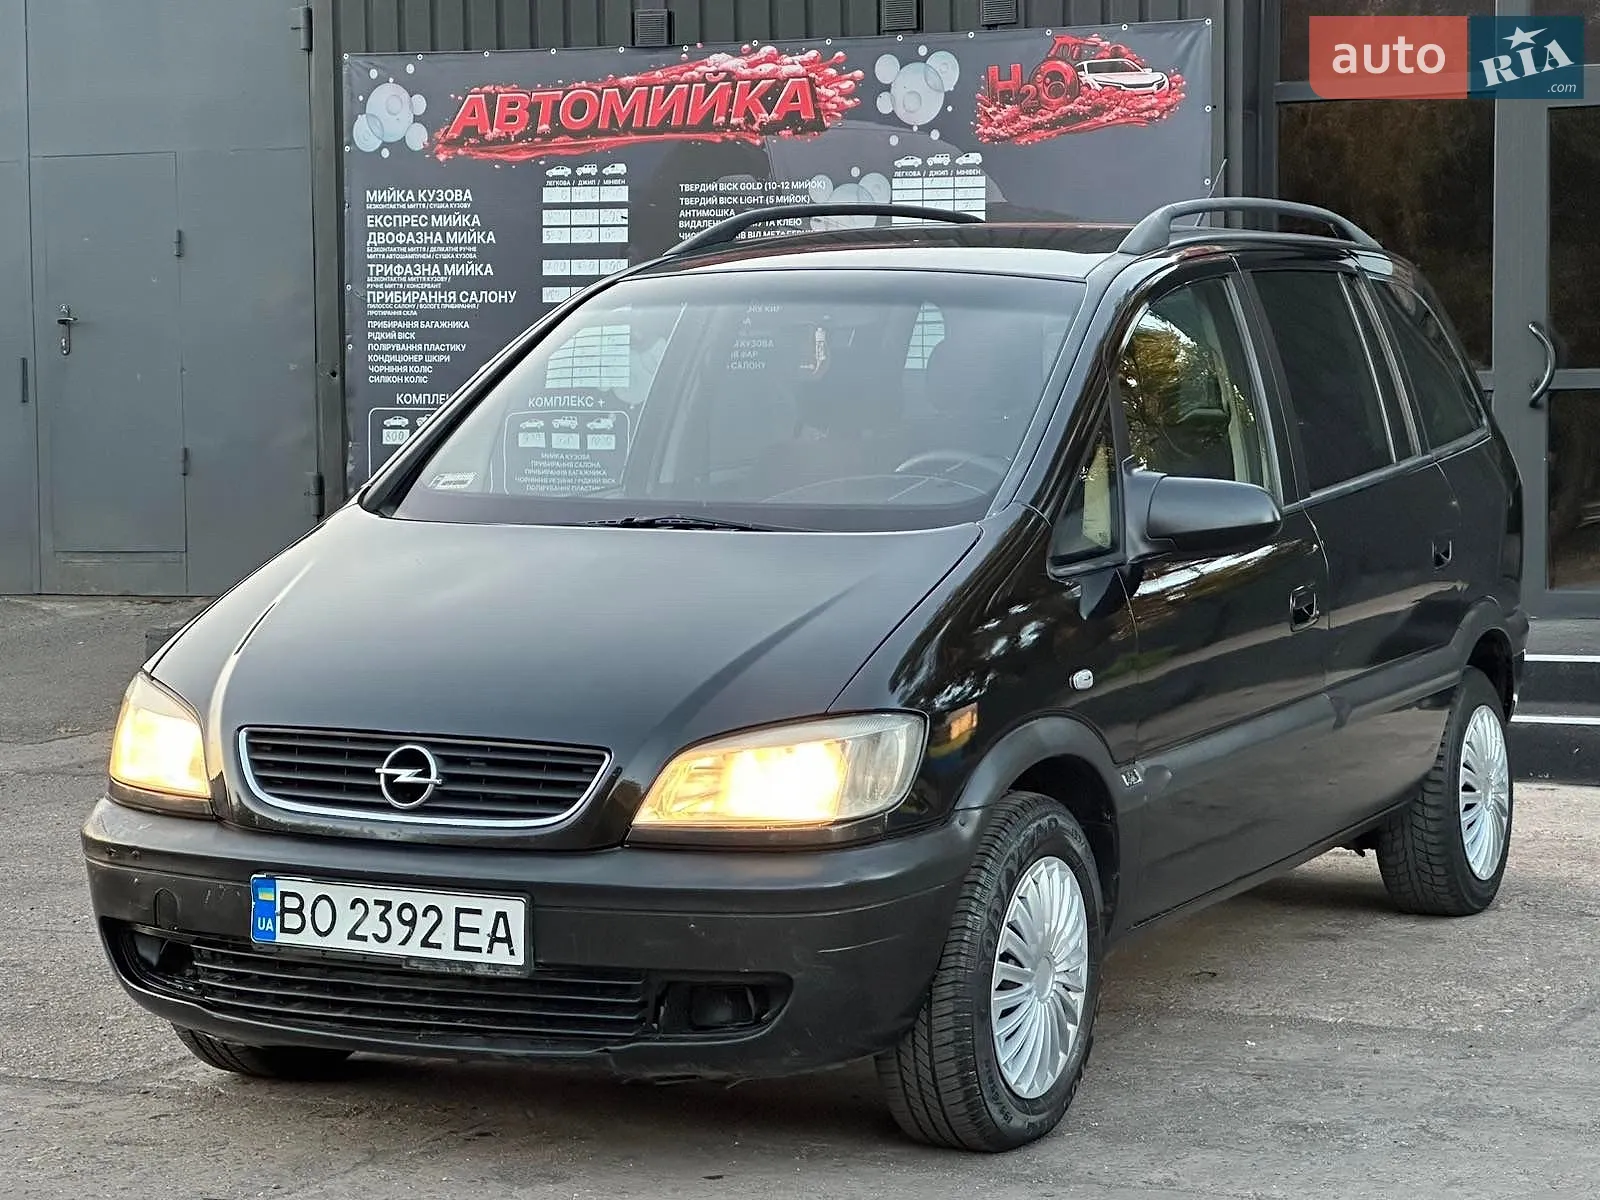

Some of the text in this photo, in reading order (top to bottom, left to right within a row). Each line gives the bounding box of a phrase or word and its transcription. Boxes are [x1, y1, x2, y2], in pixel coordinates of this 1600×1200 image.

[448, 71, 816, 138] АВТОМИЙКА
[679, 181, 718, 193] ТВЕРДИЙ
[739, 182, 763, 191] GOLD
[764, 181, 790, 192] (10-12
[791, 180, 826, 190] МИЙОК)
[366, 187, 473, 202] МИЙКА КУЗОВА
[679, 196, 718, 206] ТВЕРДИЙ
[739, 195, 764, 204] LIGHT
[765, 195, 775, 205] (5
[775, 194, 811, 204] МИЙОК)
[366, 211, 481, 228] ЕКСПРЕС МИЙКА
[679, 209, 735, 218] АНТИМОШКА
[776, 217, 802, 227] КЛЕЮ
[366, 229, 496, 247] ДВОФАЗНА МИЙКА
[367, 261, 494, 277] ТРИФАЗНА МИЙКА
[366, 290, 517, 303] ПРИБИРАННЯ САЛОНУ
[367, 320, 470, 329] ПРИБИРАННЯ БАГАЖНИКА
[367, 331, 416, 340] РІДКИЙ ВІСК
[367, 343, 467, 352] ПОЛІРУВАННЯ ПЛАСТИКУ
[367, 354, 451, 363] КОНДИЦІОНЕР ШКІРИ
[368, 365, 433, 373] ЧОРНІННЯ КОЛІС
[368, 375, 429, 384] СИЛІКОН КОЛІС
[396, 393, 449, 405] КОМПЛЕ
[528, 395, 594, 408] КОМПЛЕКС
[257, 916, 275, 933] UA
[279, 890, 516, 957] BO 2392 EA
